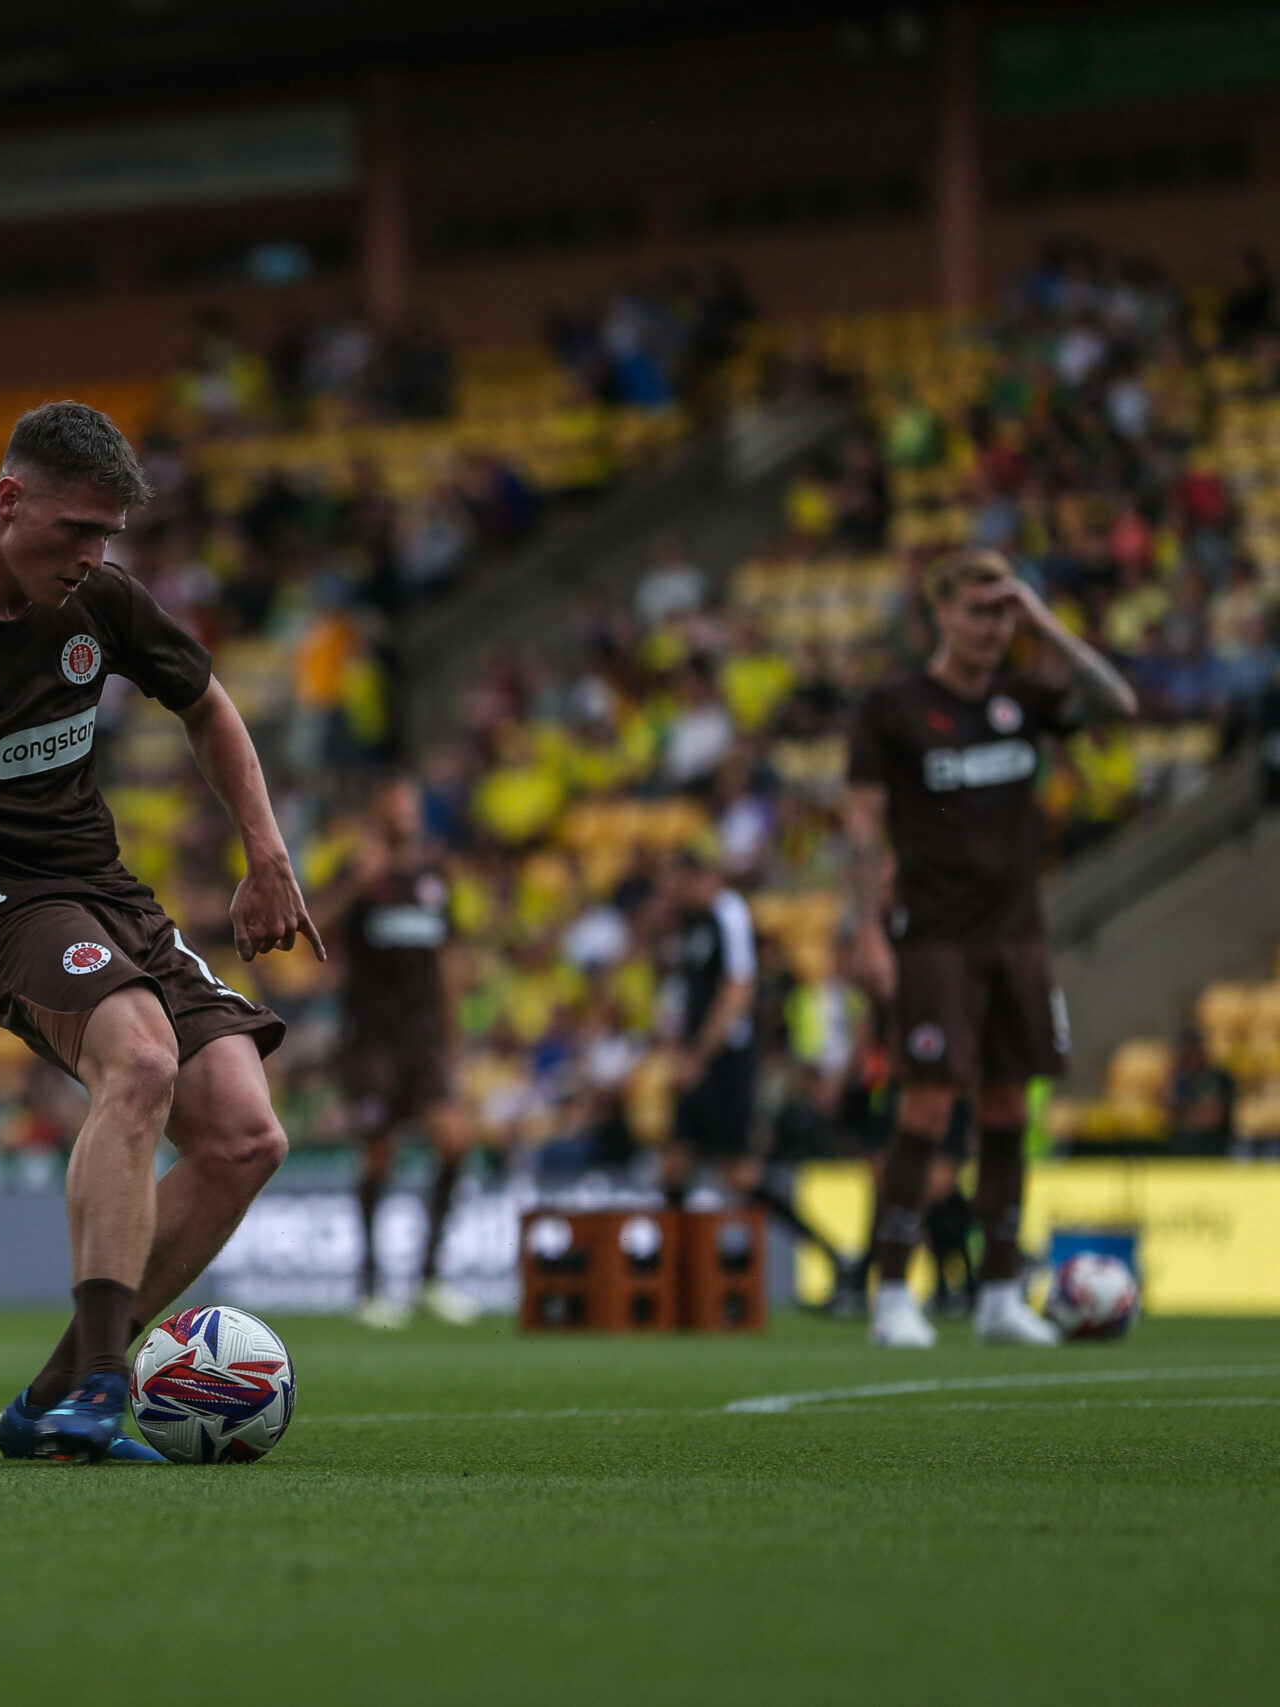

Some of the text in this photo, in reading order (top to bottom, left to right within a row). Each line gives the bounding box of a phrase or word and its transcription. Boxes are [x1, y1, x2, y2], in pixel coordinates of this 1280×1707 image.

[79, 636, 99, 655] PAULI
[75, 673, 92, 682] 1910
[2, 720, 94, 763] congstar
[89, 959, 107, 971] 1910
